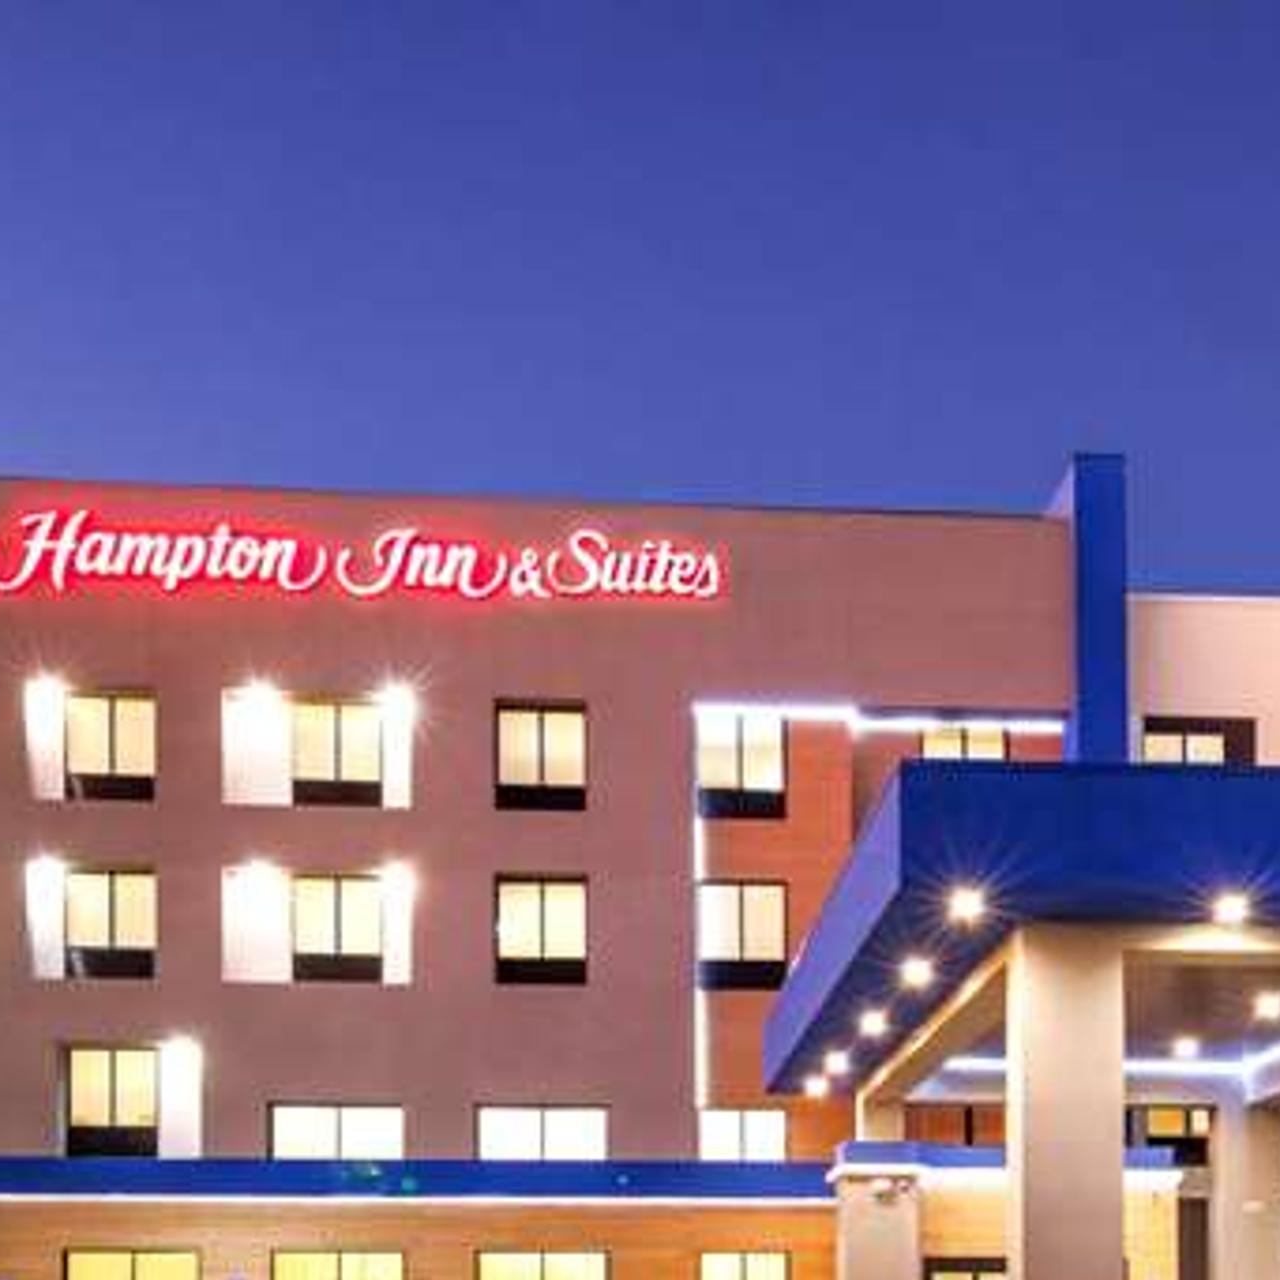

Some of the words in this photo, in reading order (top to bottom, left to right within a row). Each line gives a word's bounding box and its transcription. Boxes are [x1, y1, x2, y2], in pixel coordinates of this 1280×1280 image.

[336, 528, 507, 598] Inn
[509, 547, 552, 598] &
[547, 529, 718, 598] Suites
